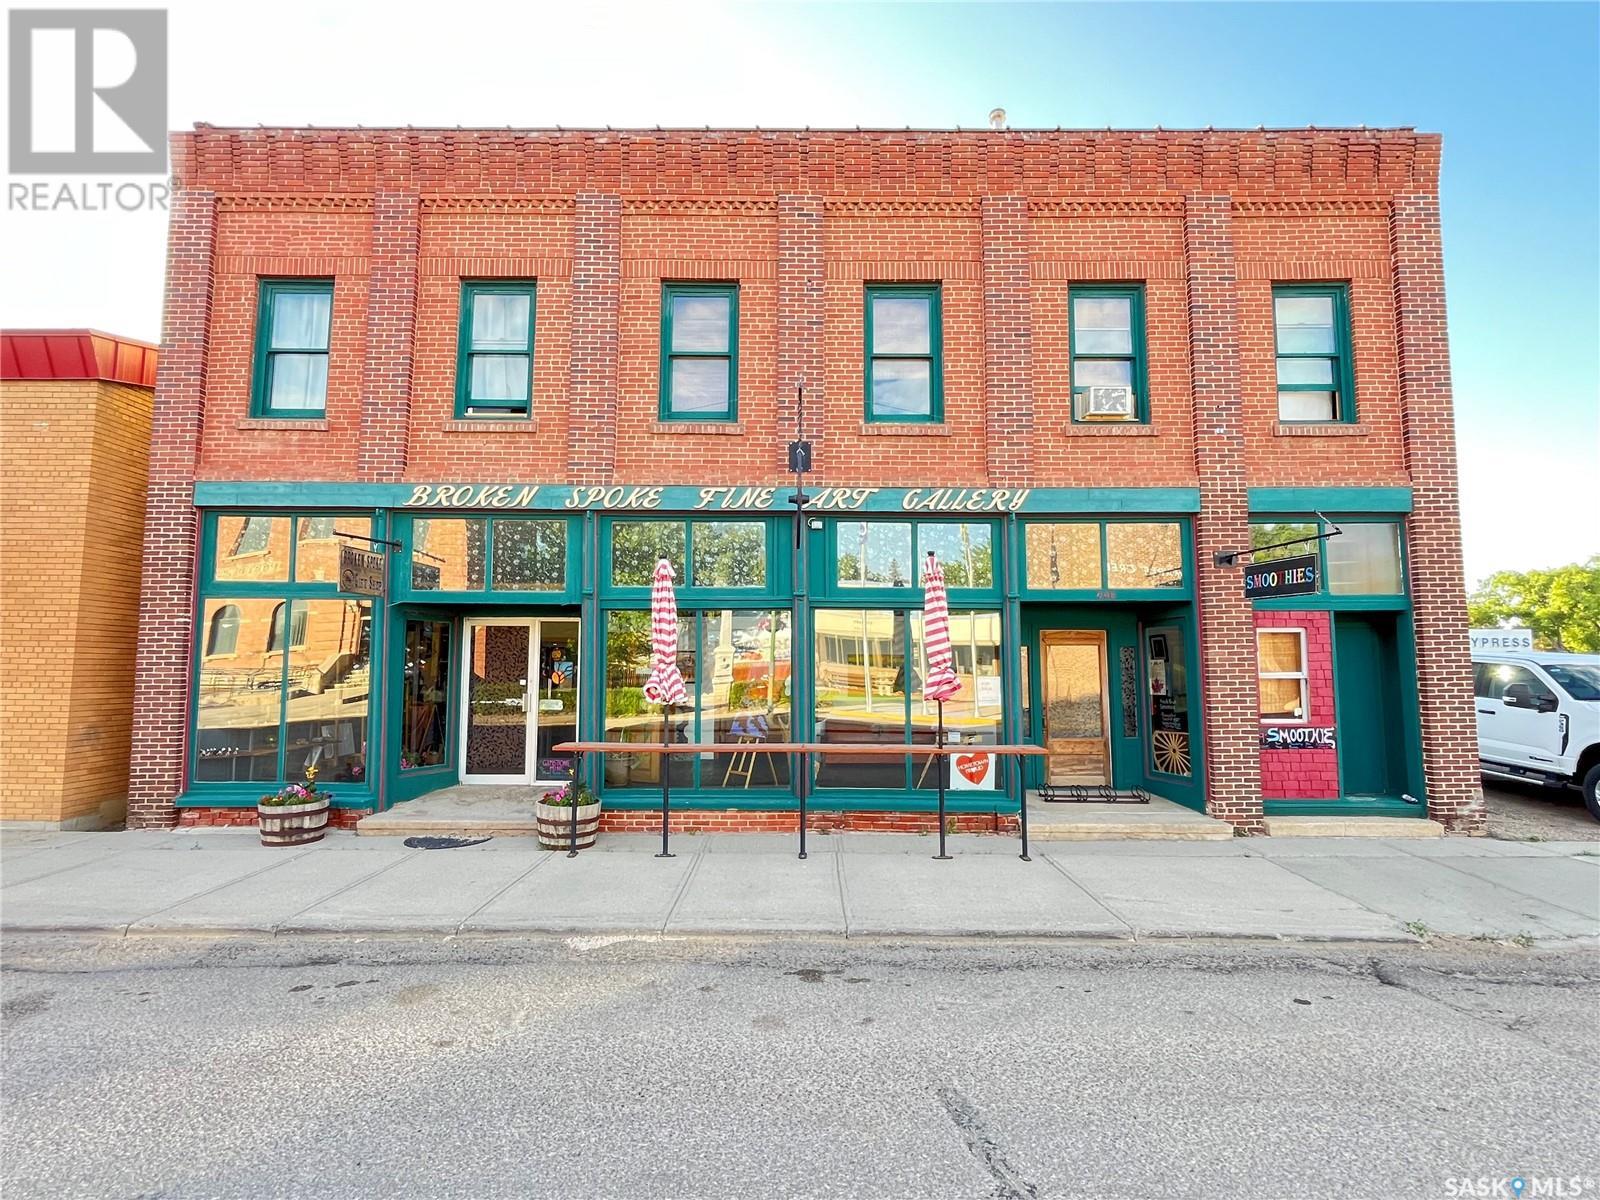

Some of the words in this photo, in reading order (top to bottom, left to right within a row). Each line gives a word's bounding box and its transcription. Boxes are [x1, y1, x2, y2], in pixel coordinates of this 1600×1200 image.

[402, 484, 539, 508] BROKEN
[565, 486, 663, 509] SPOKE
[693, 486, 775, 510] FINE
[800, 487, 880, 510] ART
[901, 487, 1030, 511] GALLERY
[1246, 567, 1315, 589] SMOOTHIES
[1471, 637, 1531, 648] YPRESS
